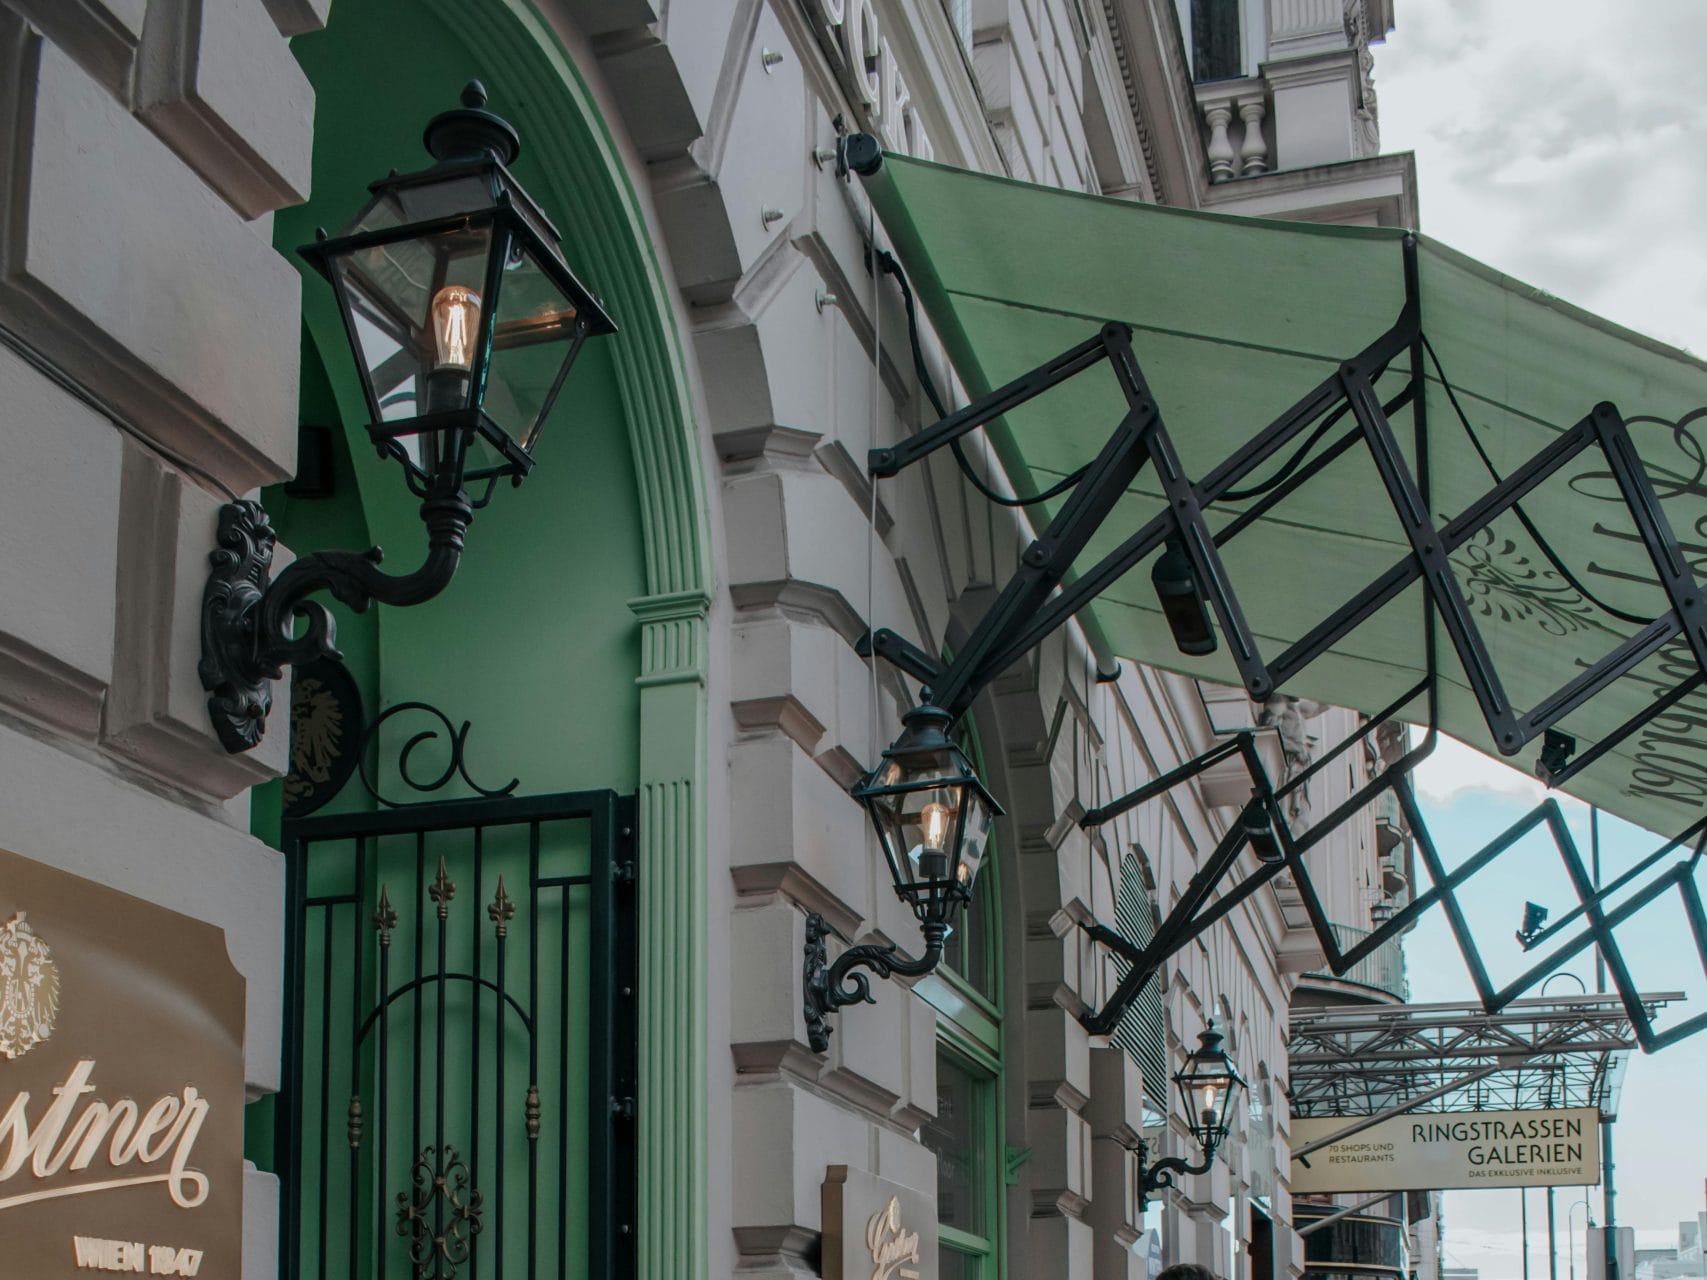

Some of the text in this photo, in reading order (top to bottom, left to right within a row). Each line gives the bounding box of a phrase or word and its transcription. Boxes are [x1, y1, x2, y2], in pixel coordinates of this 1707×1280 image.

[1412, 1118, 1582, 1143] RINGSTRASSEN
[1328, 1142, 1395, 1153] 70 SHOPS UND
[1467, 1143, 1583, 1165] GALERIEN
[1328, 1153, 1395, 1164] RESTAURANTS
[1468, 1166, 1583, 1178] DAS EXKLUSIVE INKLUSIVE
[74, 1235, 145, 1273] WIEN
